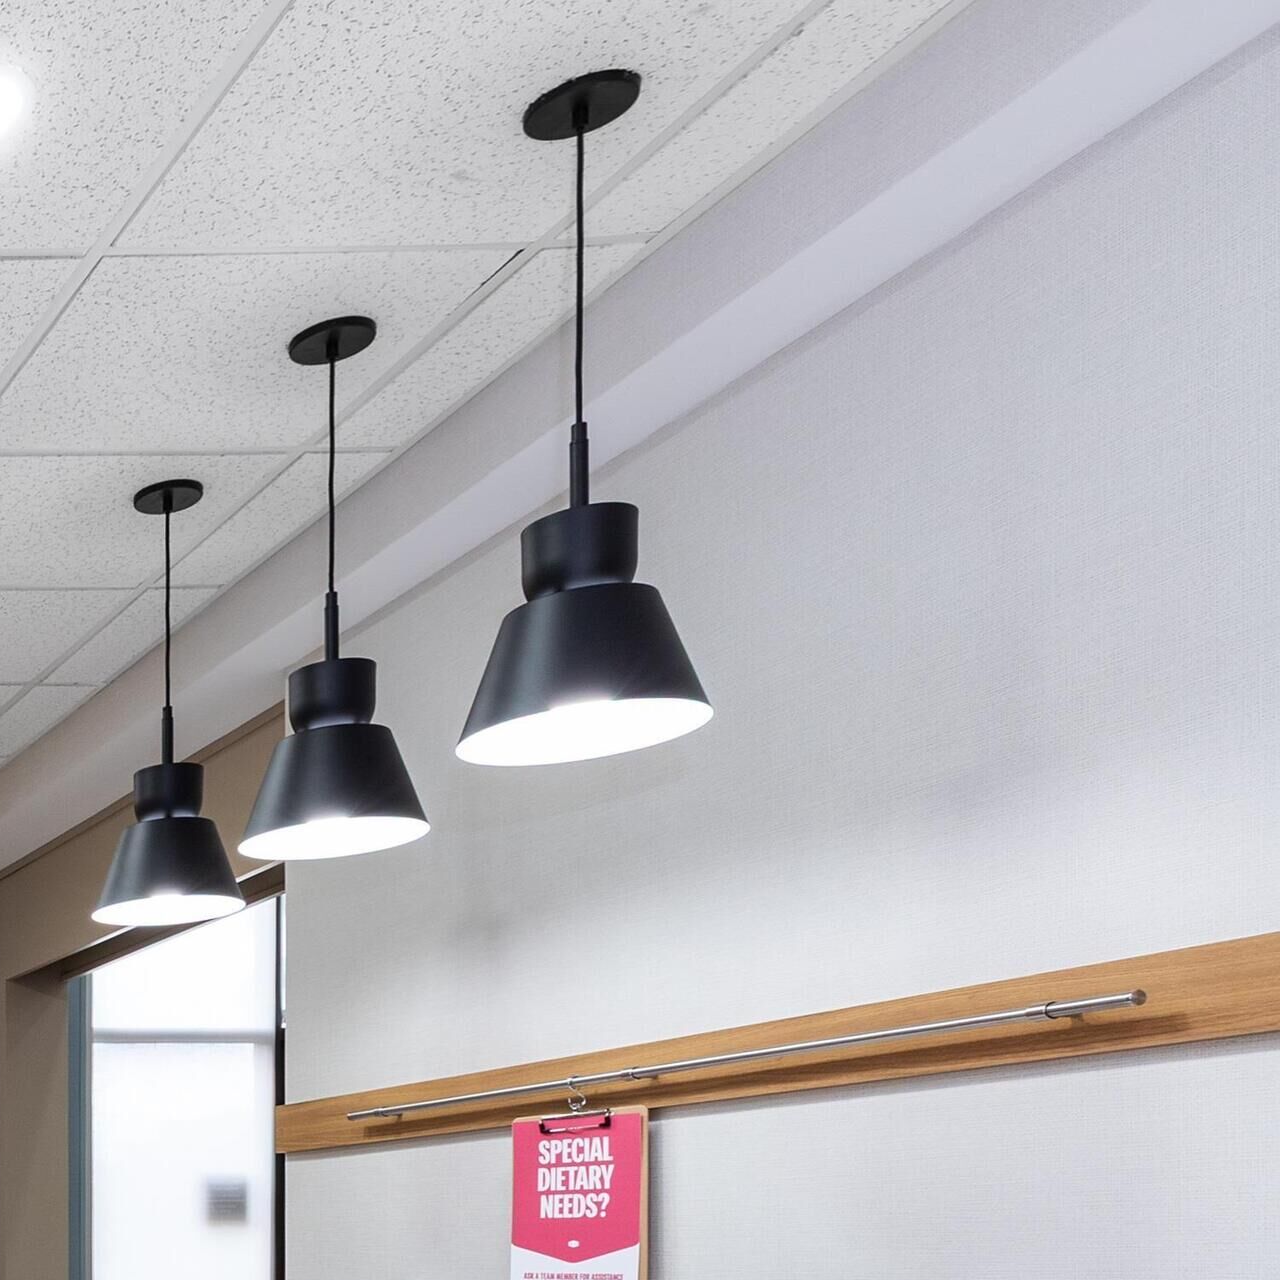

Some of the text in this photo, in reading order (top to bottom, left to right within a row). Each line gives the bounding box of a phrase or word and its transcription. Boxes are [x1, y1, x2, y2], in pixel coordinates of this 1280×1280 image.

[538, 1137, 613, 1165] SPECIAL
[537, 1164, 614, 1192] DIETARY
[540, 1193, 610, 1219] NEEDS?
